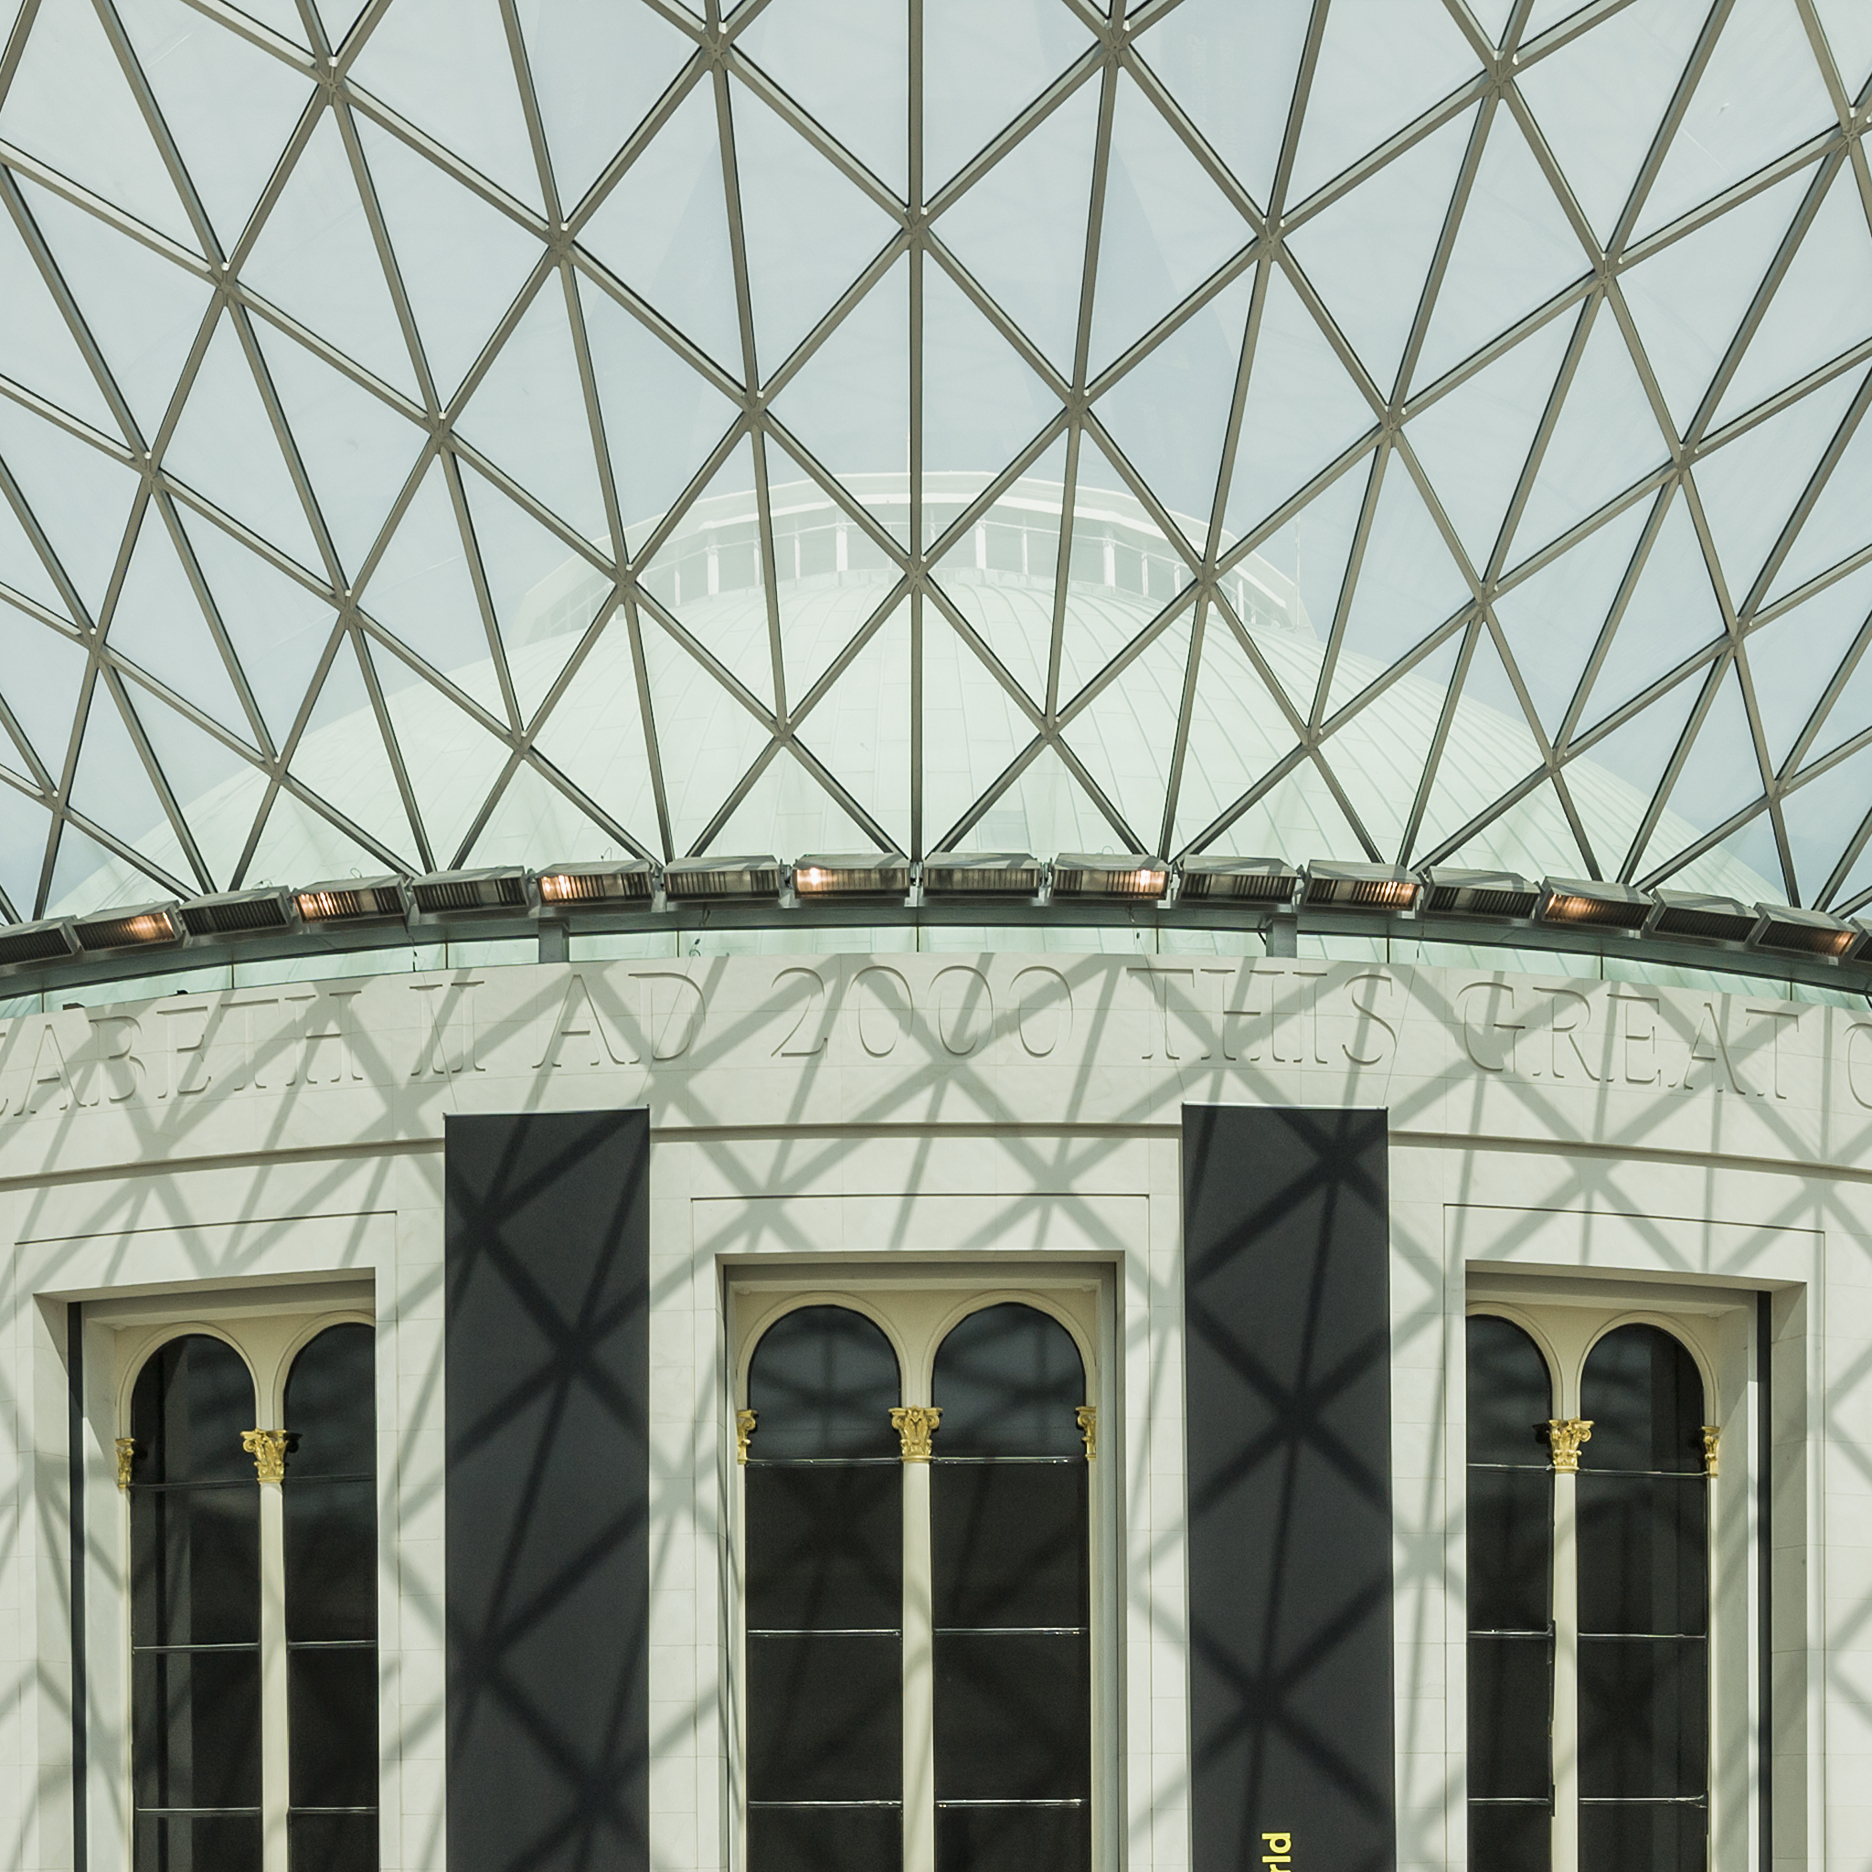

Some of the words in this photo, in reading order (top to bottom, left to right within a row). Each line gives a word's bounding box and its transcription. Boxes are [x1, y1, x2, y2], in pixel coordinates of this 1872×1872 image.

[531, 973, 706, 1069] AD
[771, 965, 1074, 1059] 2000
[1126, 968, 1398, 1065] THIS
[1456, 981, 1799, 1100] GREAT
